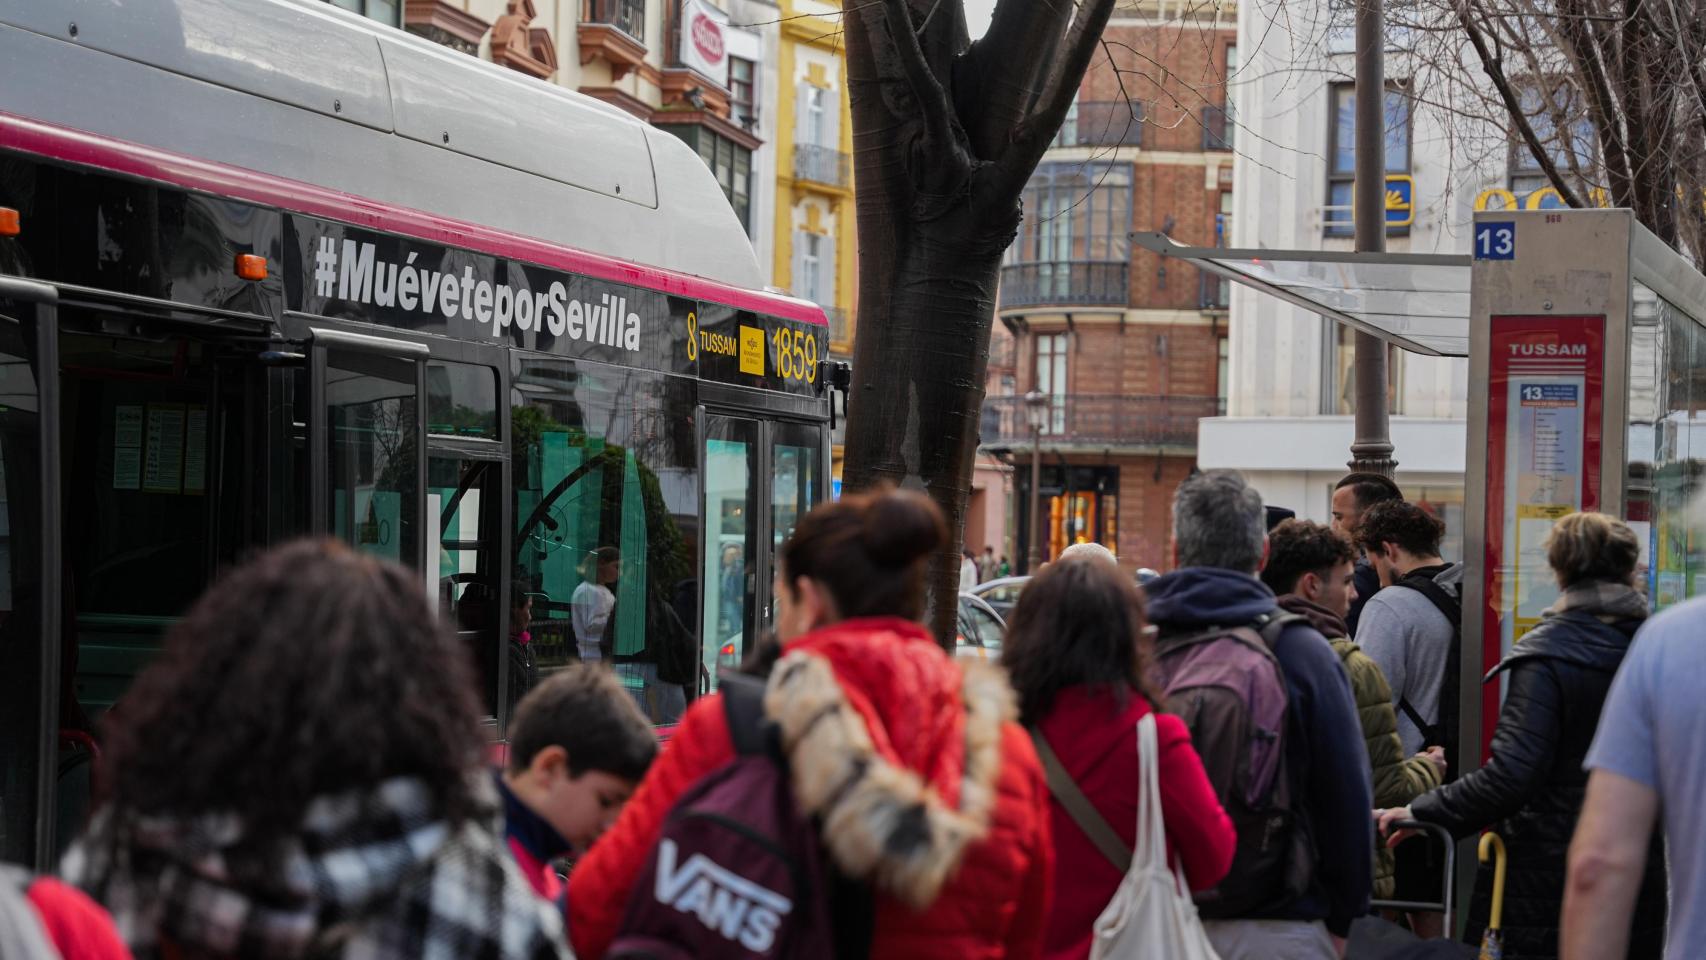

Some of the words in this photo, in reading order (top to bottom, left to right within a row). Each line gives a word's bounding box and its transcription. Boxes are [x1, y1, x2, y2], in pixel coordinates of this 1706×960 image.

[1477, 228, 1513, 255] 13
[315, 236, 641, 351] #MuéveteporSevilla
[687, 312, 697, 361] 8
[700, 330, 737, 357] TUSSAM
[773, 327, 817, 384] 1859
[1508, 343, 1587, 355] TUSSAM
[1523, 386, 1542, 400] 13
[654, 837, 793, 953] VANS
